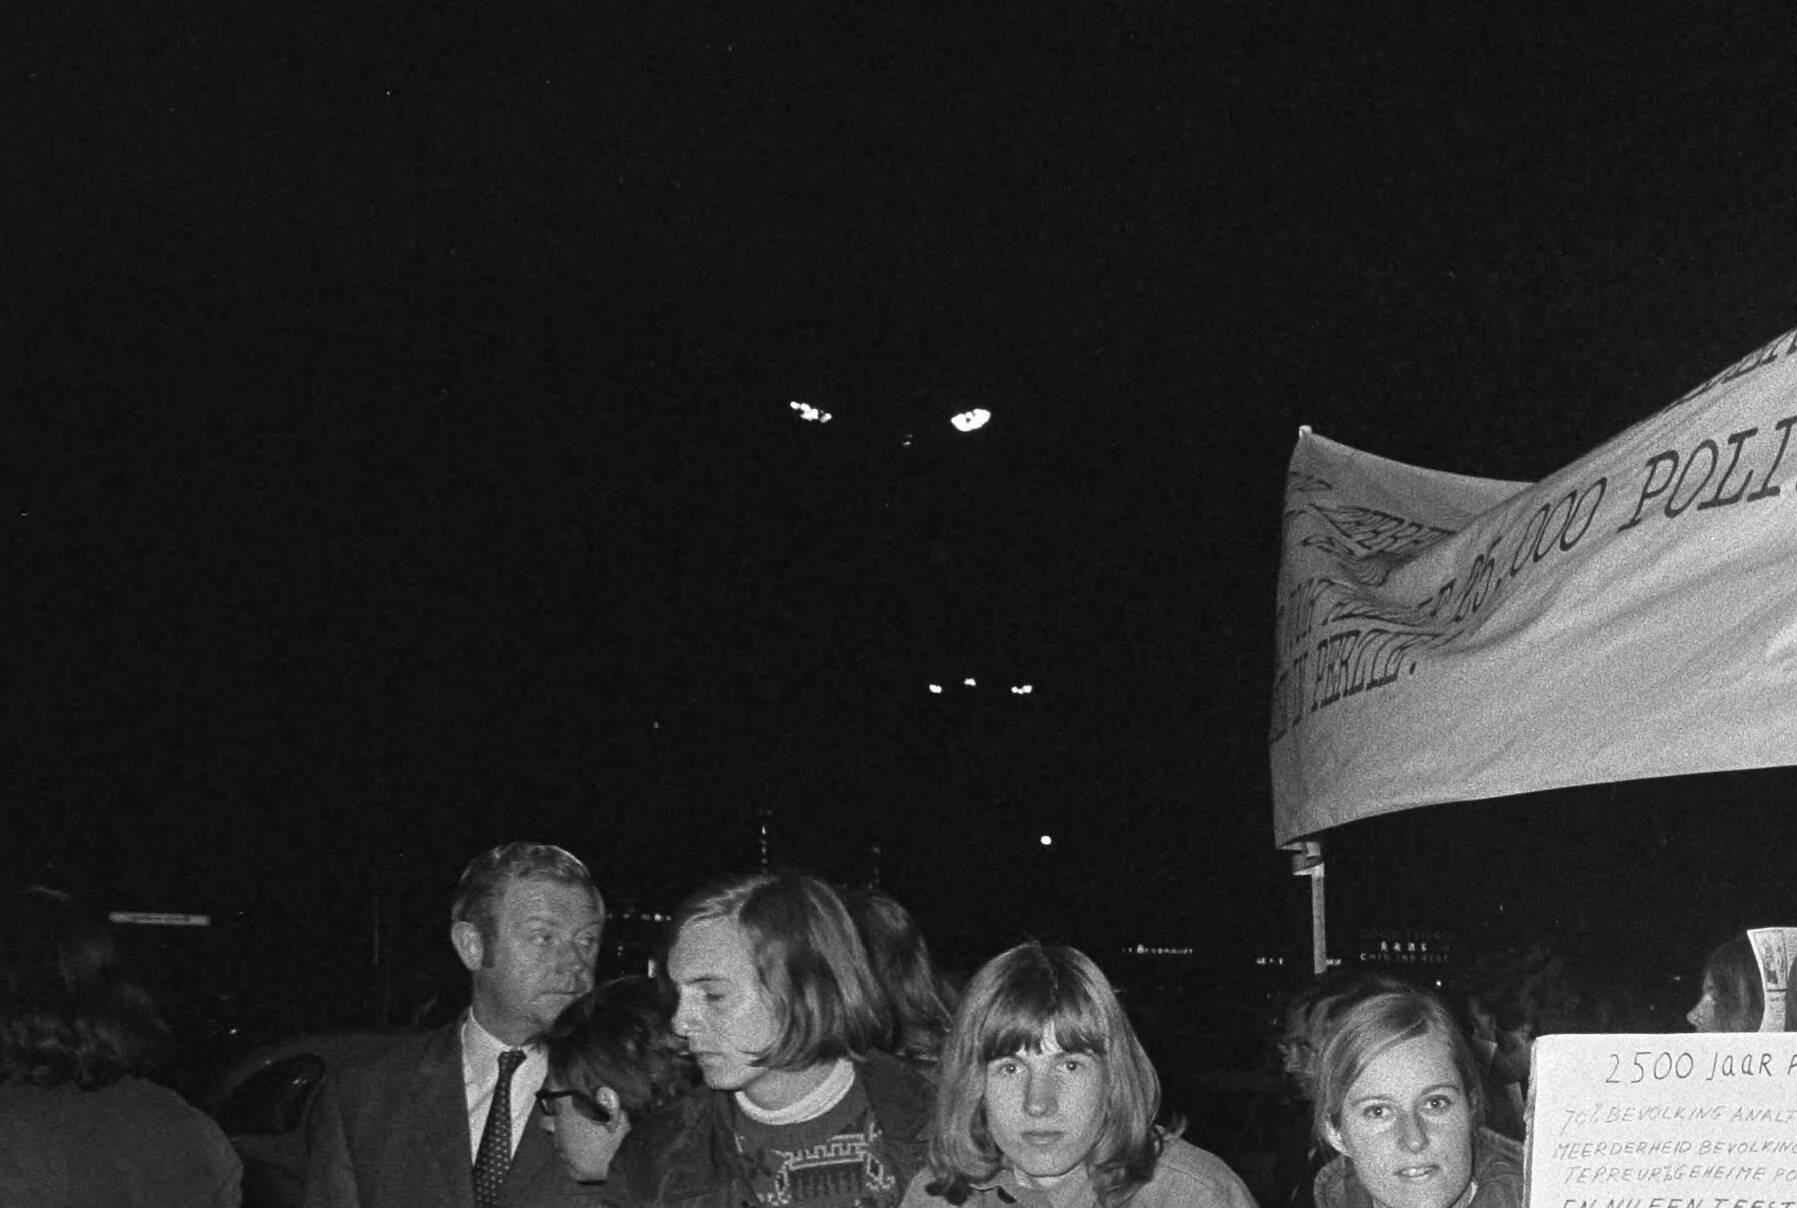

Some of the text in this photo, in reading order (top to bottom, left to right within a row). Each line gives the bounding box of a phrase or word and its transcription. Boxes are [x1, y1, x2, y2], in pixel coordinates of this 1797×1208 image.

[1605, 1051, 1695, 1083] 2500
[1604, 1105, 1727, 1124] BEVOLKING
[1553, 1140, 1693, 1161] MEERDERHEID
